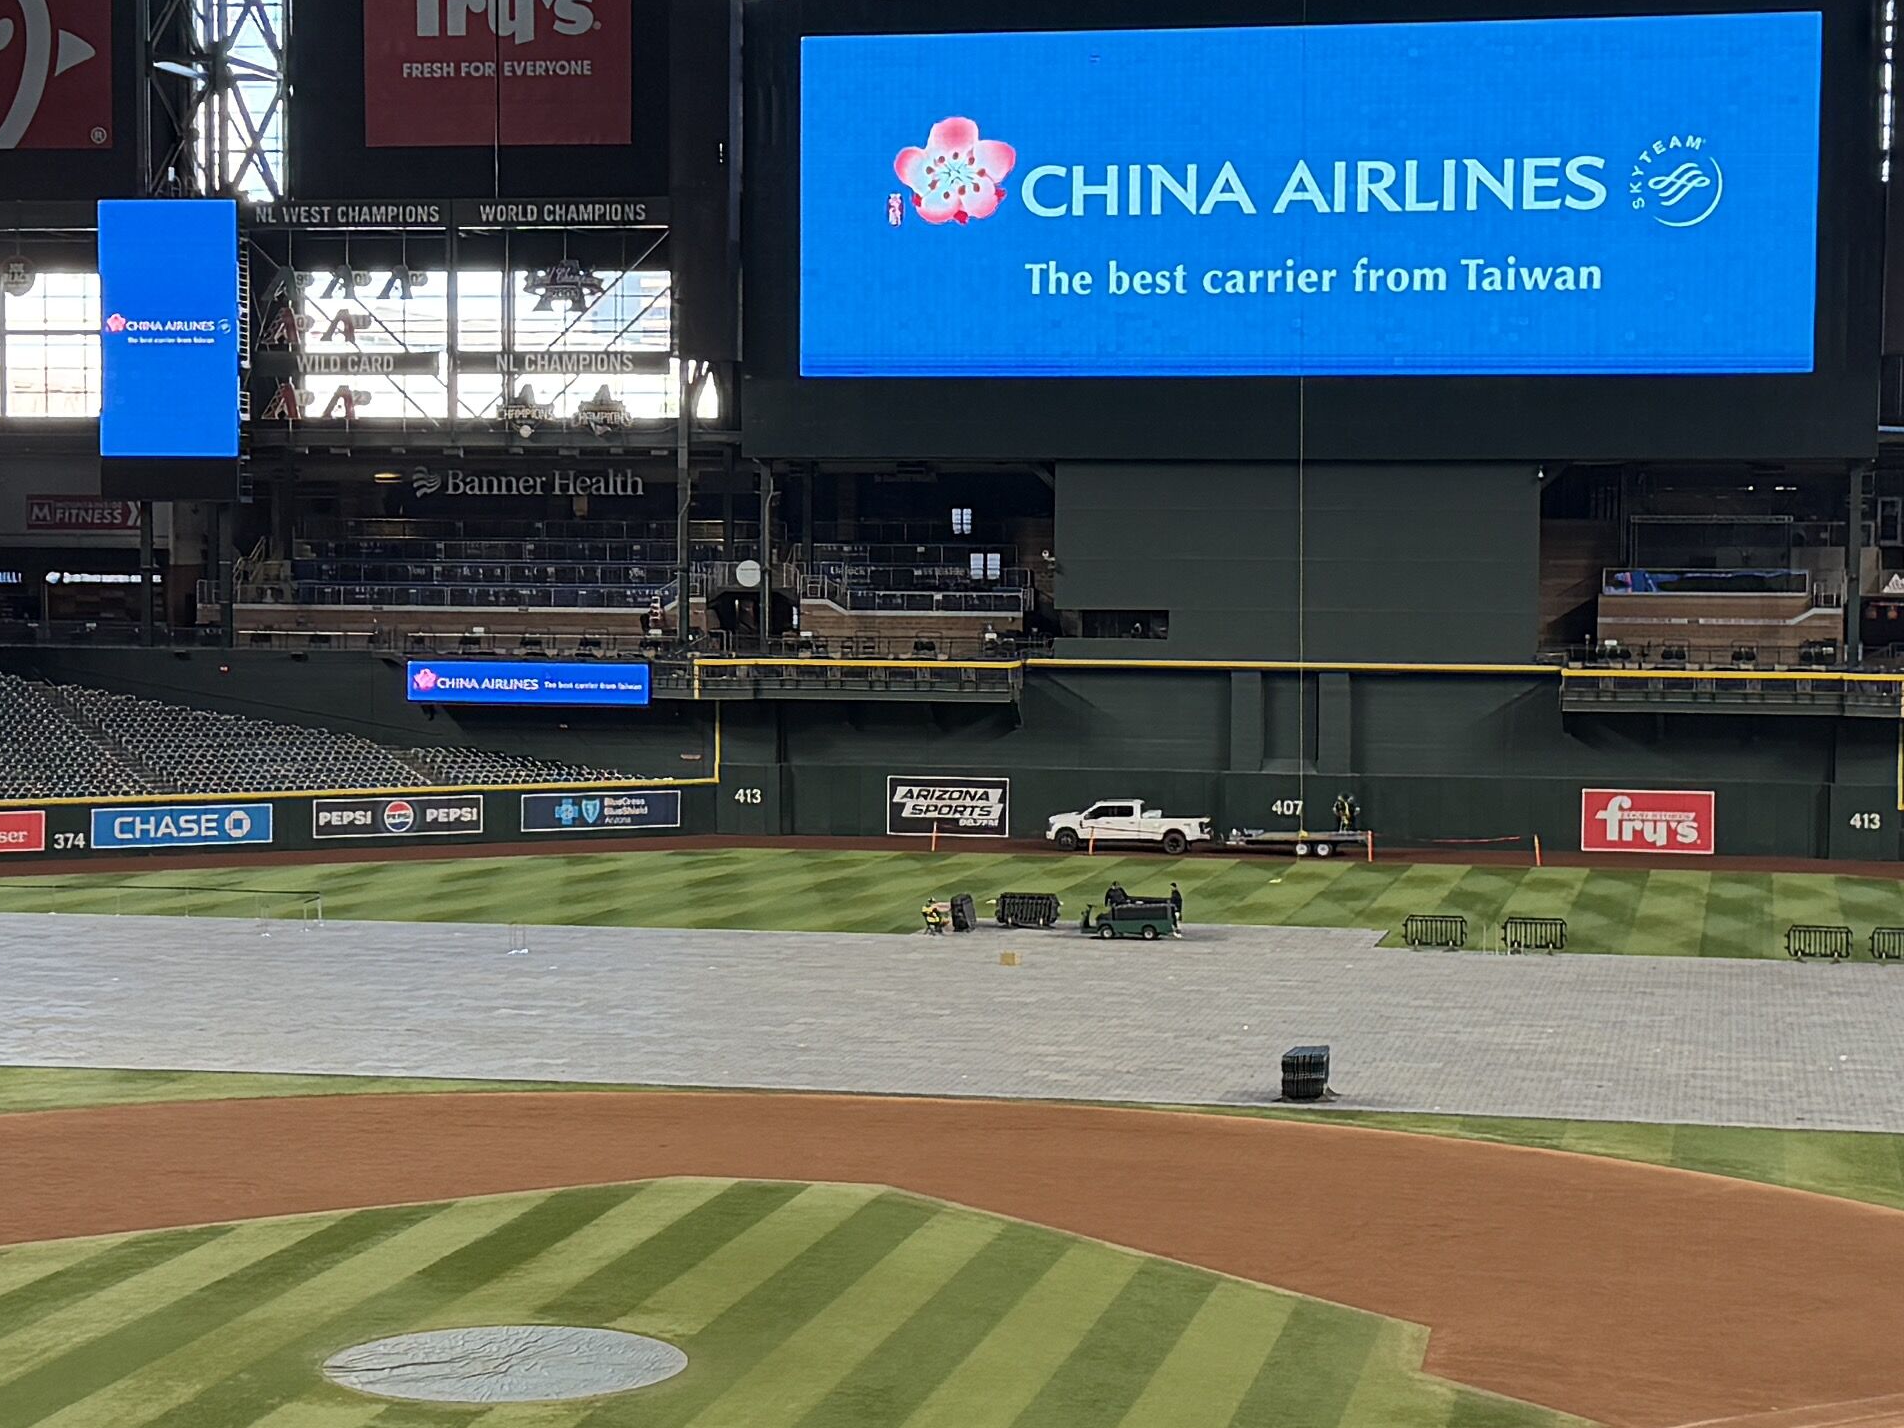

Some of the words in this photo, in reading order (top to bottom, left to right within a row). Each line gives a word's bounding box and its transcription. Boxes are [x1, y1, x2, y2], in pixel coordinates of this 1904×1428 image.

[402, 60, 455, 79] FRESH
[460, 60, 497, 78] FOR
[502, 59, 593, 77] EVERYONE
[1629, 133, 1707, 211] SKYTEAM
[1020, 160, 1257, 218] CHINA
[1272, 154, 1608, 215] AIRLINES
[256, 206, 277, 224] NL
[282, 206, 332, 223] WEST
[337, 205, 441, 224] CHAMPIONS
[479, 204, 538, 222] WORLD
[543, 203, 648, 222] CHAMPIONS
[1025, 261, 1092, 296] The
[1107, 259, 1188, 296] best
[1202, 258, 1337, 295] carrier
[1352, 255, 1448, 293] from
[1459, 254, 1602, 291] Taiwan
[296, 355, 341, 373] WILD
[347, 355, 395, 373] CARD
[496, 354, 519, 373] NL
[524, 353, 634, 373] CHAMPIONS
[446, 469, 547, 497] Banner
[552, 468, 645, 497] Health
[56, 509, 122, 524] FITNESS
[604, 797, 646, 806] BlueCross
[734, 788, 762, 804] 413
[901, 788, 991, 802] ARIZONA
[425, 807, 478, 822] PEPSI
[604, 806, 648, 815] BlueShield
[910, 803, 993, 818] SPORTS
[1271, 799, 1304, 816] 407
[113, 814, 220, 839] CHASE
[318, 811, 372, 826] PEPSI
[604, 816, 632, 825] Arizona
[1604, 795, 1699, 847] fry's
[1849, 813, 1881, 829] 413
[53, 832, 86, 849] 374
